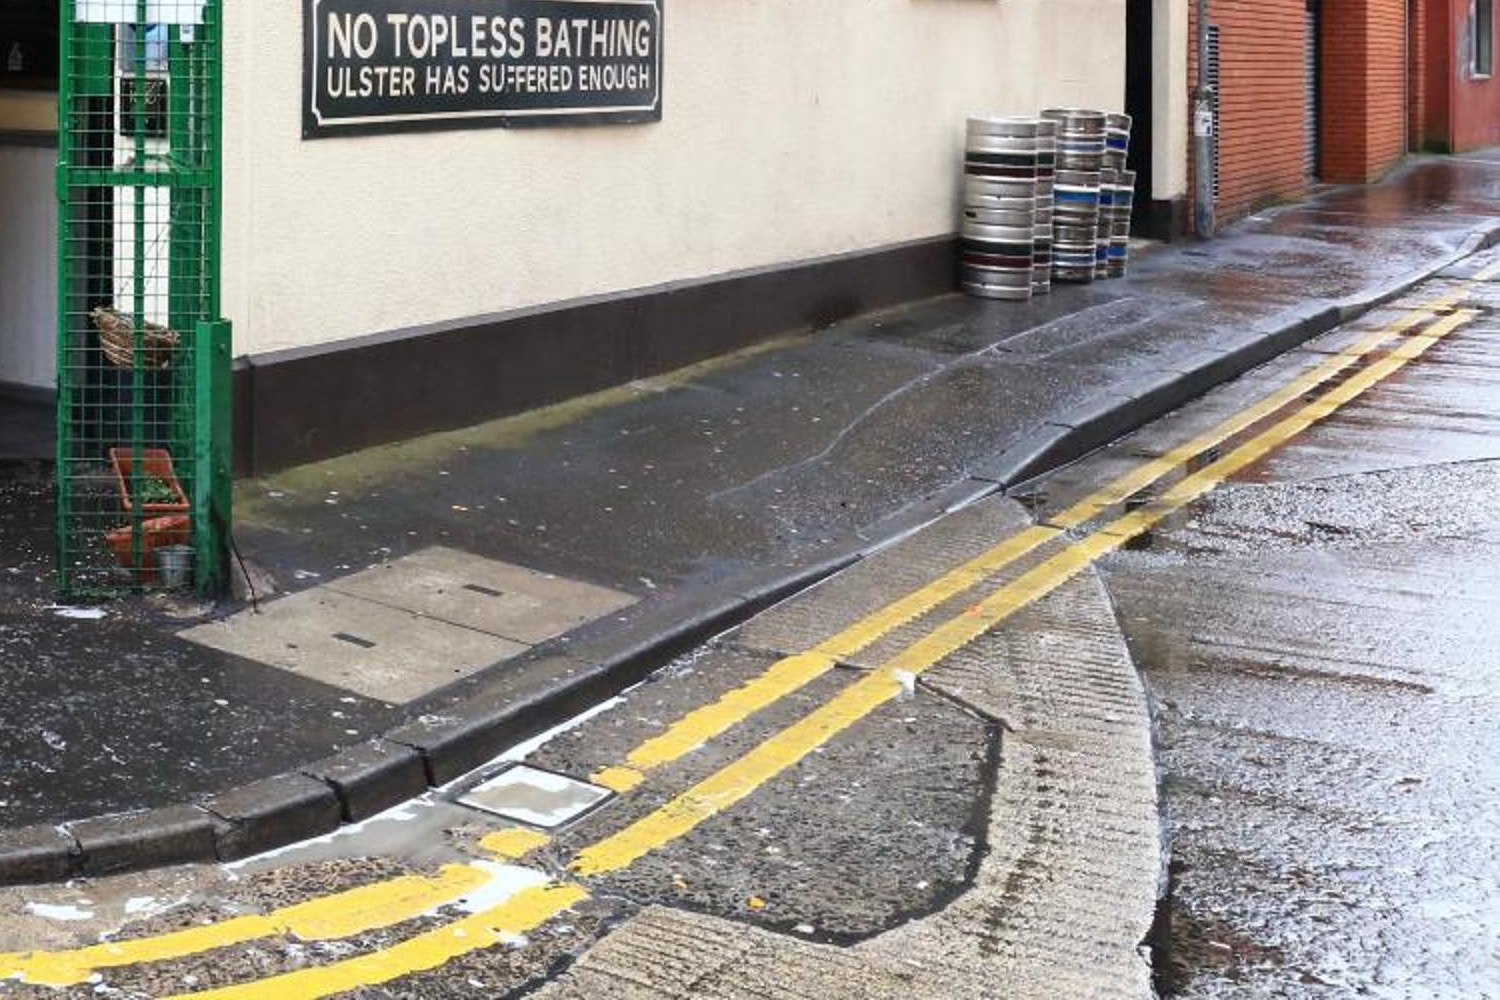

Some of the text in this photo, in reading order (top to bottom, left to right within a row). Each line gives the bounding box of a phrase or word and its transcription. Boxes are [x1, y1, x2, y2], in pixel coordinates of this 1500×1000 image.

[327, 12, 650, 59] NO TOPLESS BATHING
[327, 64, 650, 98] ULSTER HAS SUFFERED ENOUGH
